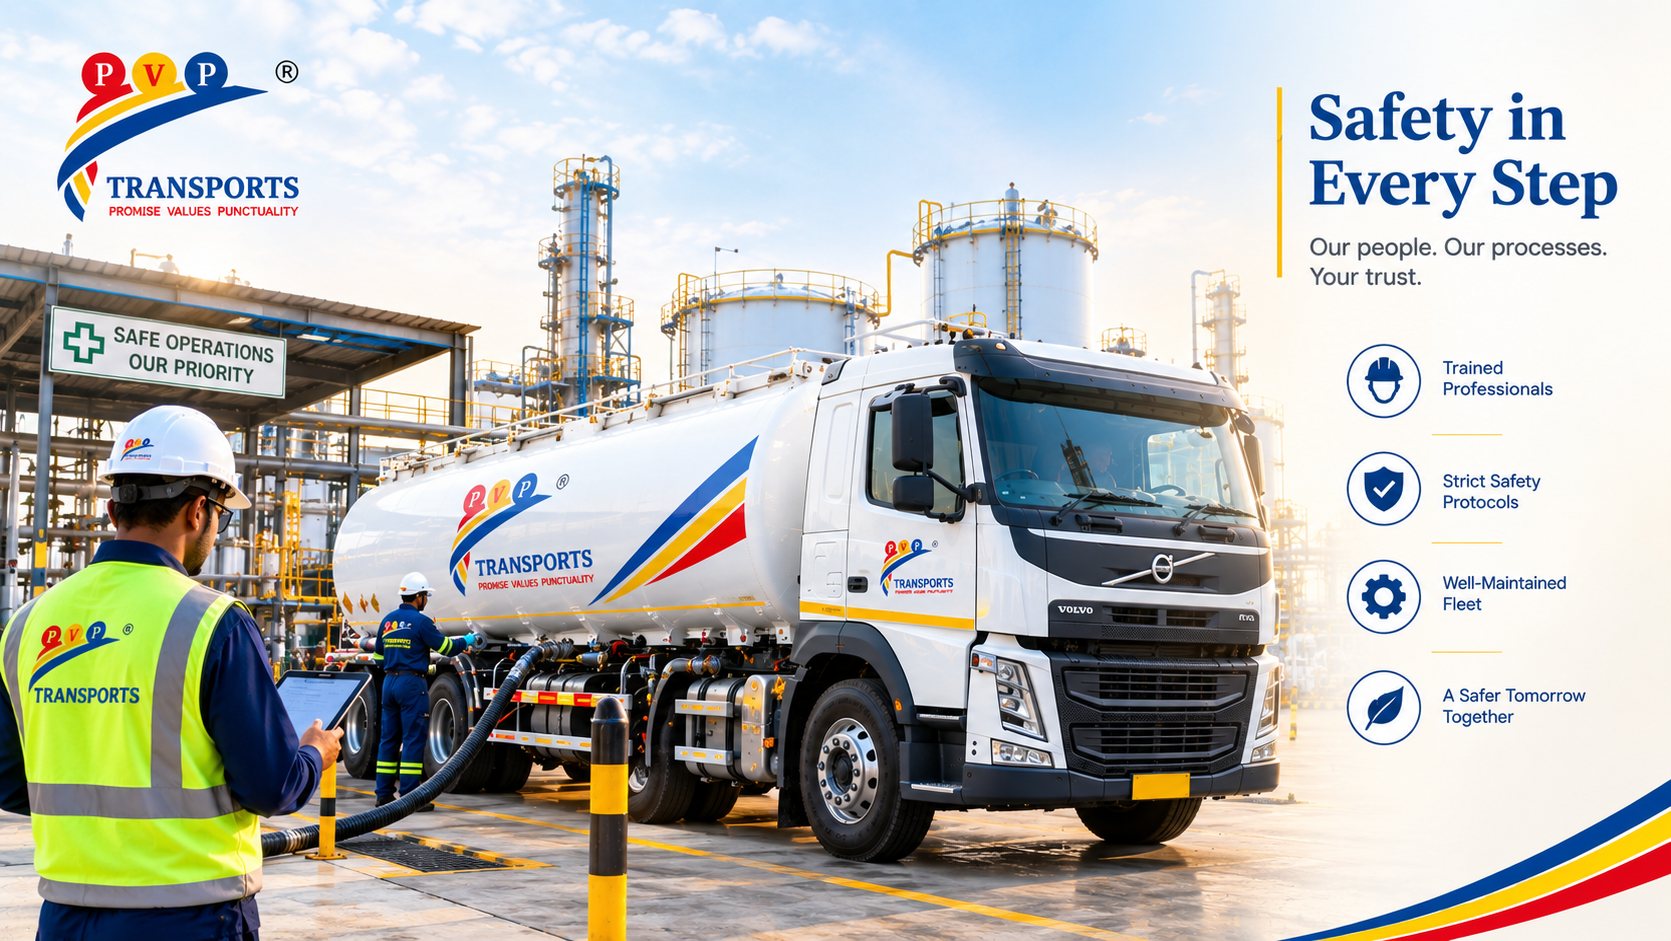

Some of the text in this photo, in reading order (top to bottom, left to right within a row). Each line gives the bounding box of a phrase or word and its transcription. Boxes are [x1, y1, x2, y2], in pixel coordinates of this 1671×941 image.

[113, 326, 274, 364] SAFE OPERATIONS
[129, 353, 254, 385] OUR PRIORITY
[475, 549, 593, 576] TRANSPORTS
[478, 574, 594, 590] PROMISE VALUES PUNCTUALITY
[893, 578, 954, 589] TRANSPORTS
[1057, 605, 1093, 614] VOLVO
[34, 687, 140, 703] TRANSPORTS
